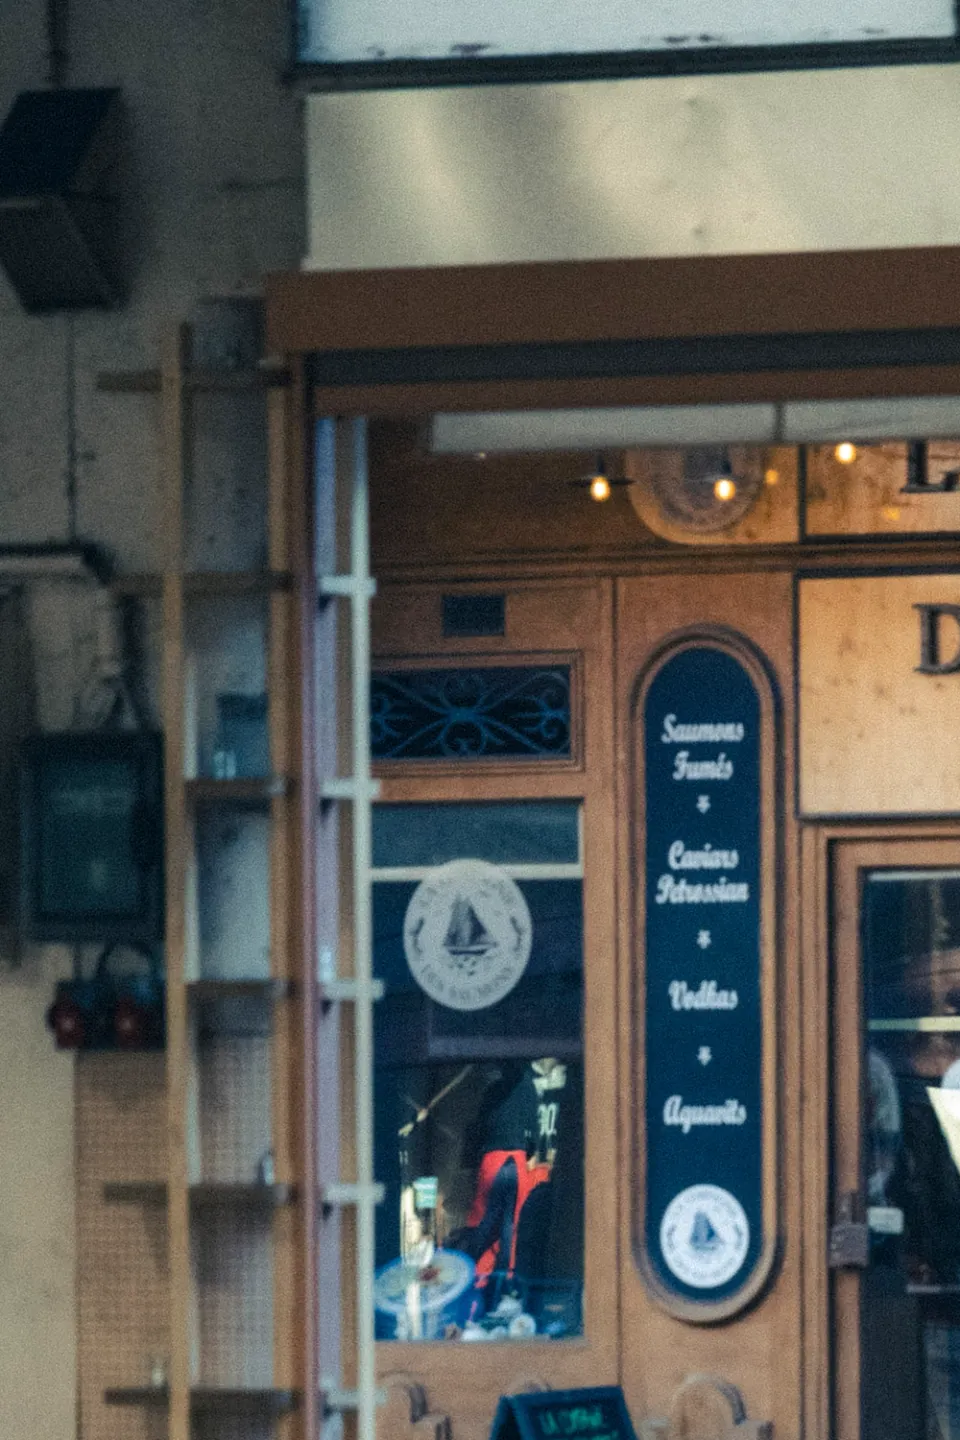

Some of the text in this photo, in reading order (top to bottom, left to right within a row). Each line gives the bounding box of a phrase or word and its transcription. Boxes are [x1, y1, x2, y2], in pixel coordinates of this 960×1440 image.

[661, 713, 745, 744] Saumons
[668, 839, 740, 871] Caviars
[668, 979, 739, 1011] Vodkas
